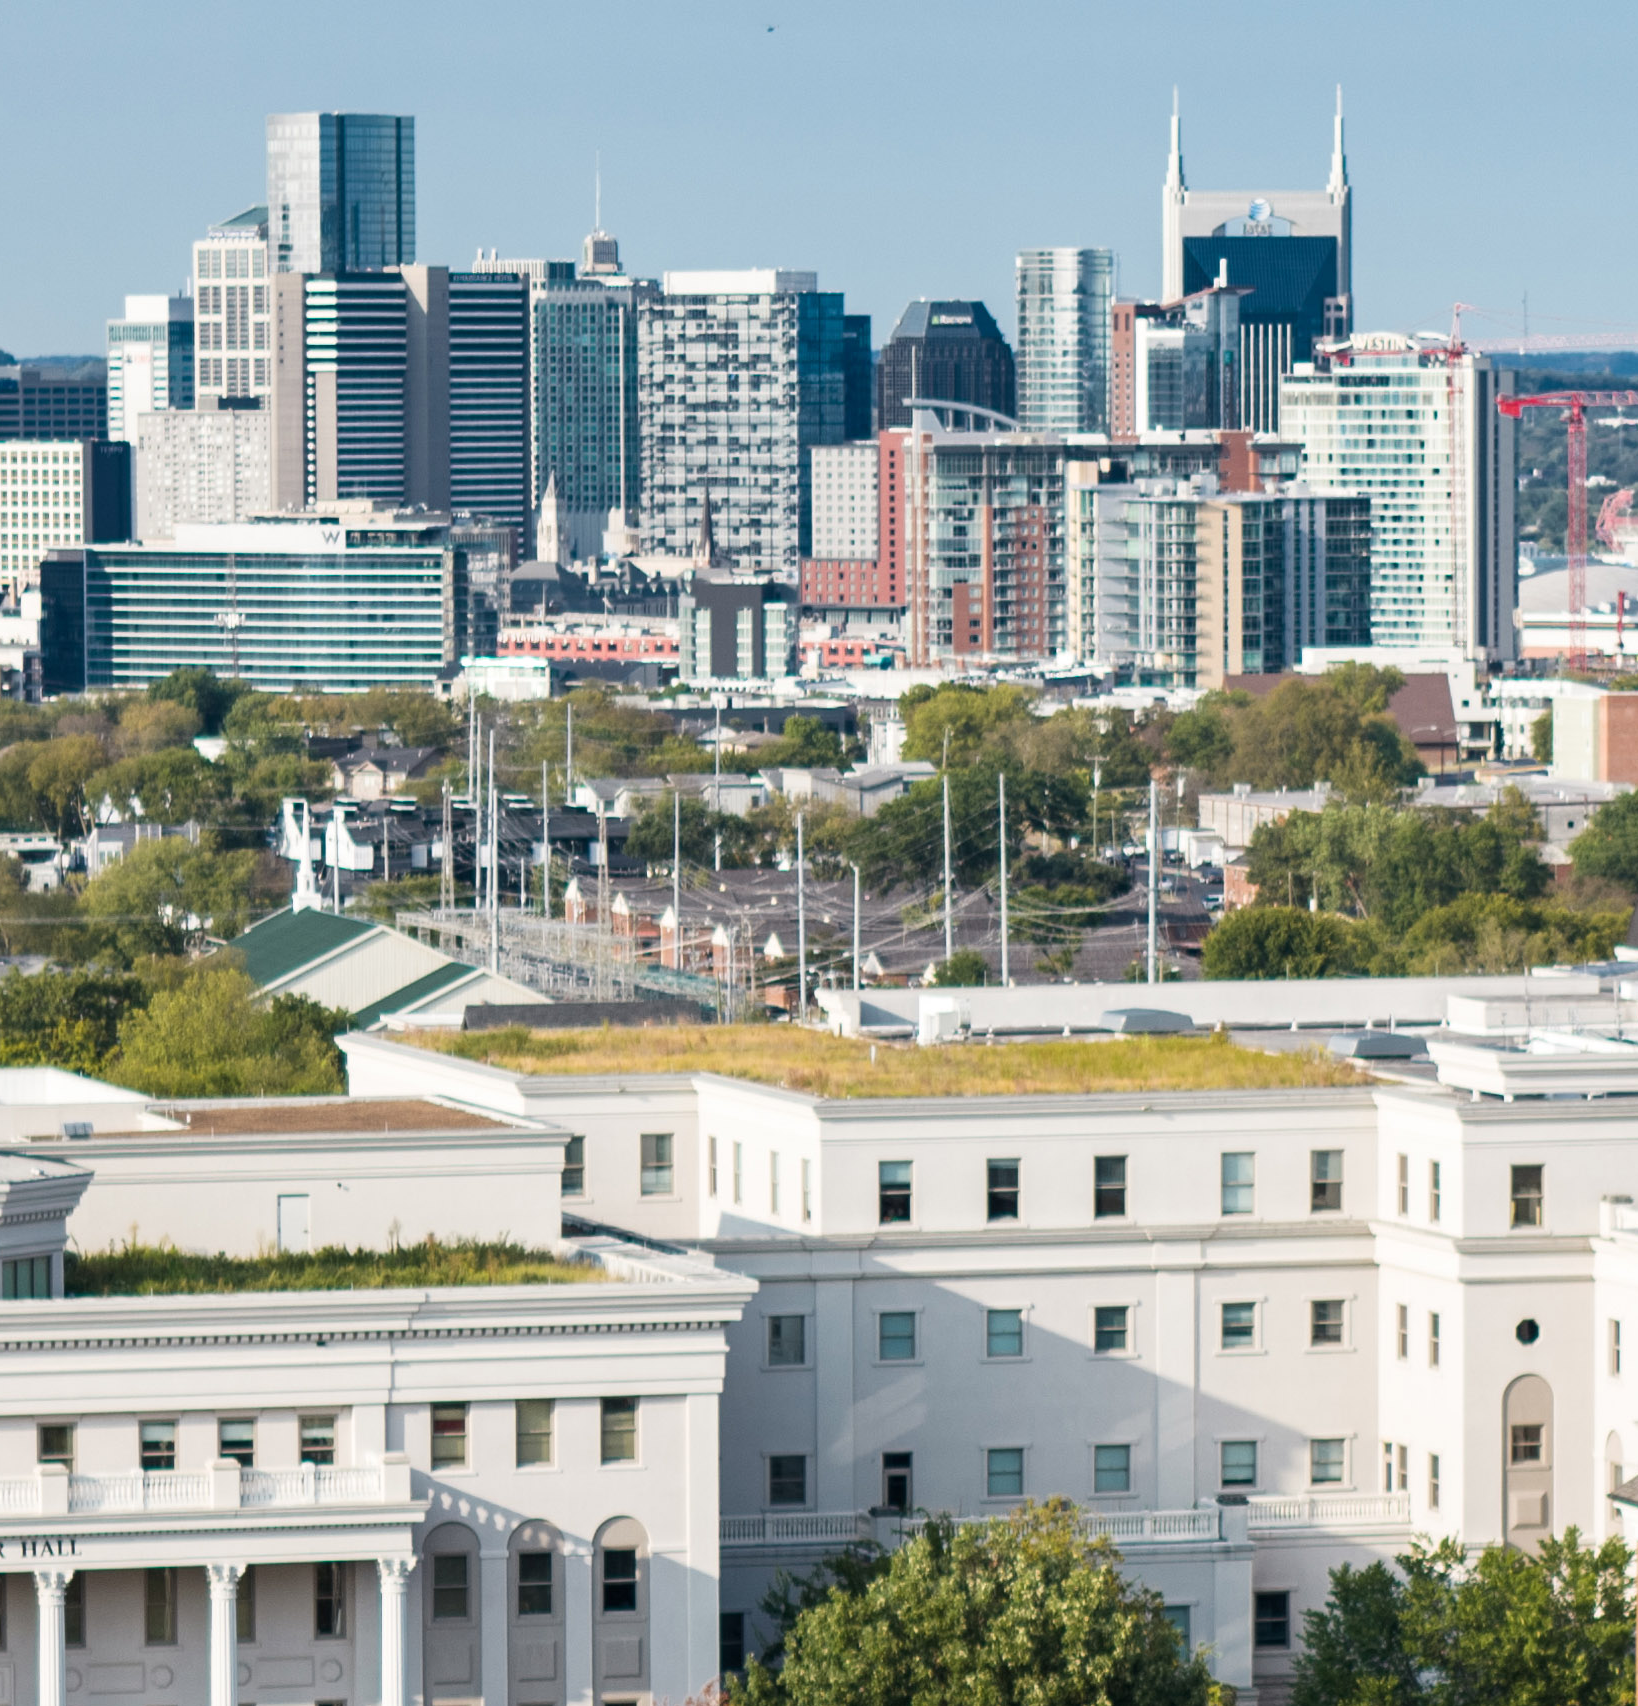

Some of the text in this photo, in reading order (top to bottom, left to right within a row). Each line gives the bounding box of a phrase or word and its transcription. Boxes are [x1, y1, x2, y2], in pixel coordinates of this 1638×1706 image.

[1350, 333, 1407, 351] WESTIN
[322, 530, 341, 545] W
[21, 1539, 83, 1559] HALL
